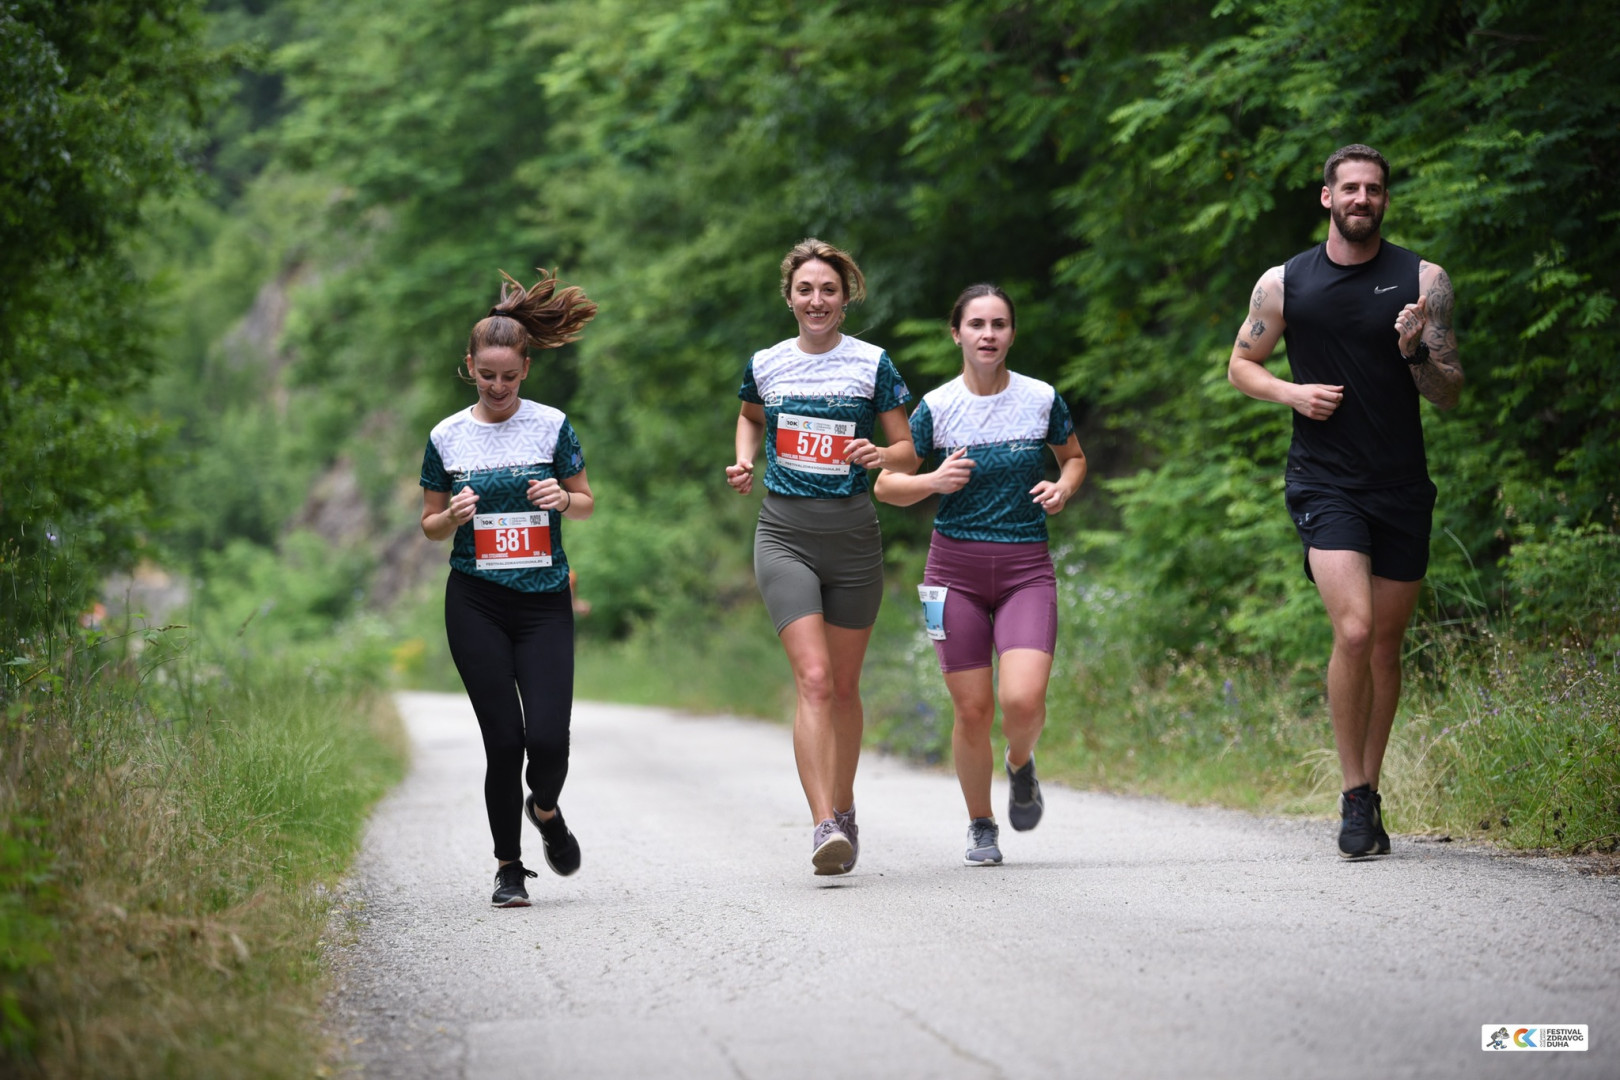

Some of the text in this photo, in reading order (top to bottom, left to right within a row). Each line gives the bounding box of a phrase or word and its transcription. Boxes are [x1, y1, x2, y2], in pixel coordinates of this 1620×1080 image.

[786, 391, 858, 400] ANDORA
[797, 432, 832, 458] 578
[496, 528, 530, 552] 581
